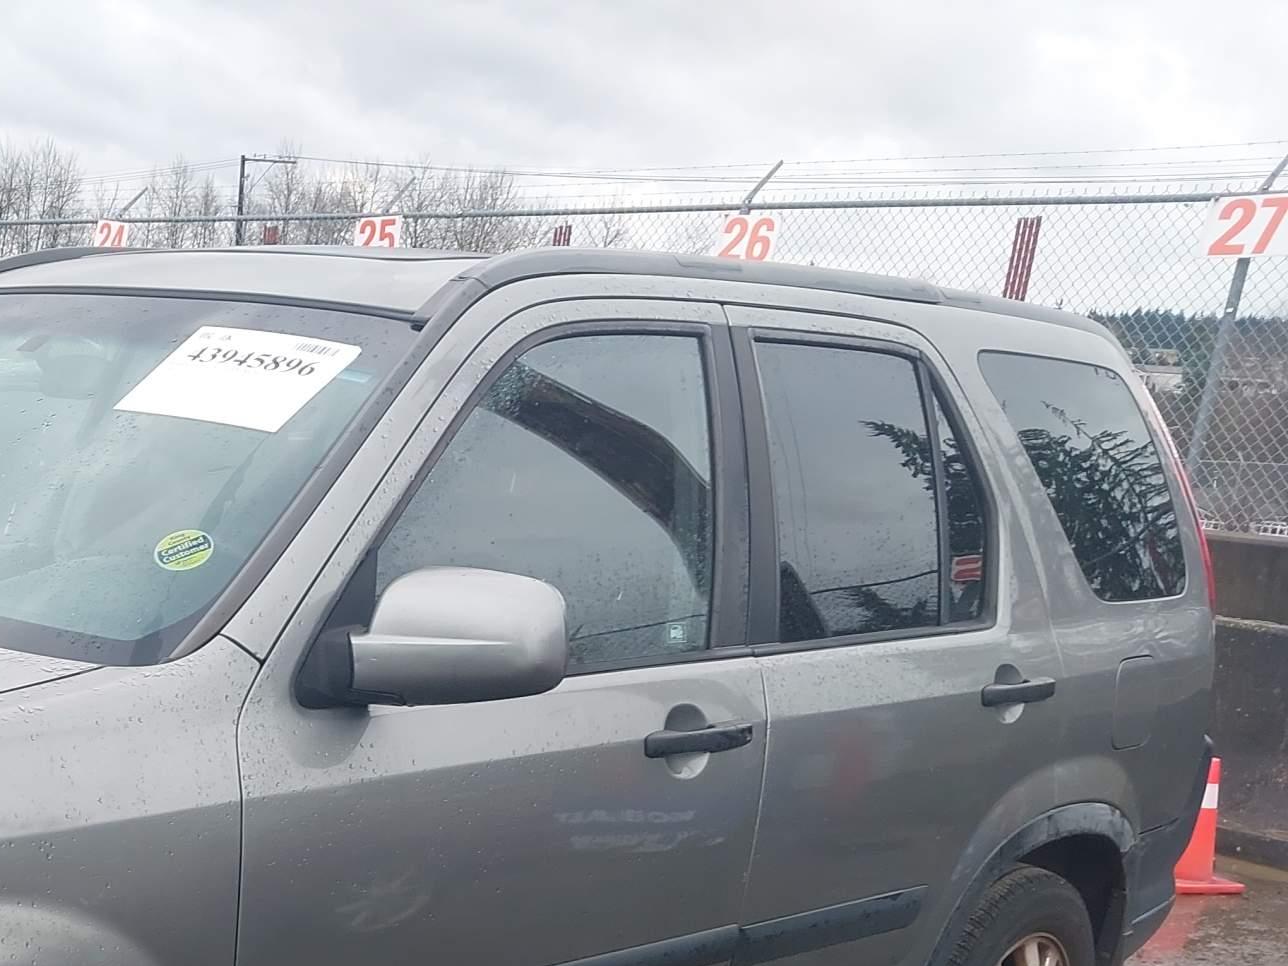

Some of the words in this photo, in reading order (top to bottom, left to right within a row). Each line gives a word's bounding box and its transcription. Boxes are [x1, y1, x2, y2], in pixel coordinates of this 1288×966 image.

[98, 222, 126, 248] 24
[359, 218, 397, 248] 25
[718, 217, 775, 261] 26
[1207, 197, 1288, 256] 27
[187, 345, 321, 377] 43945896
